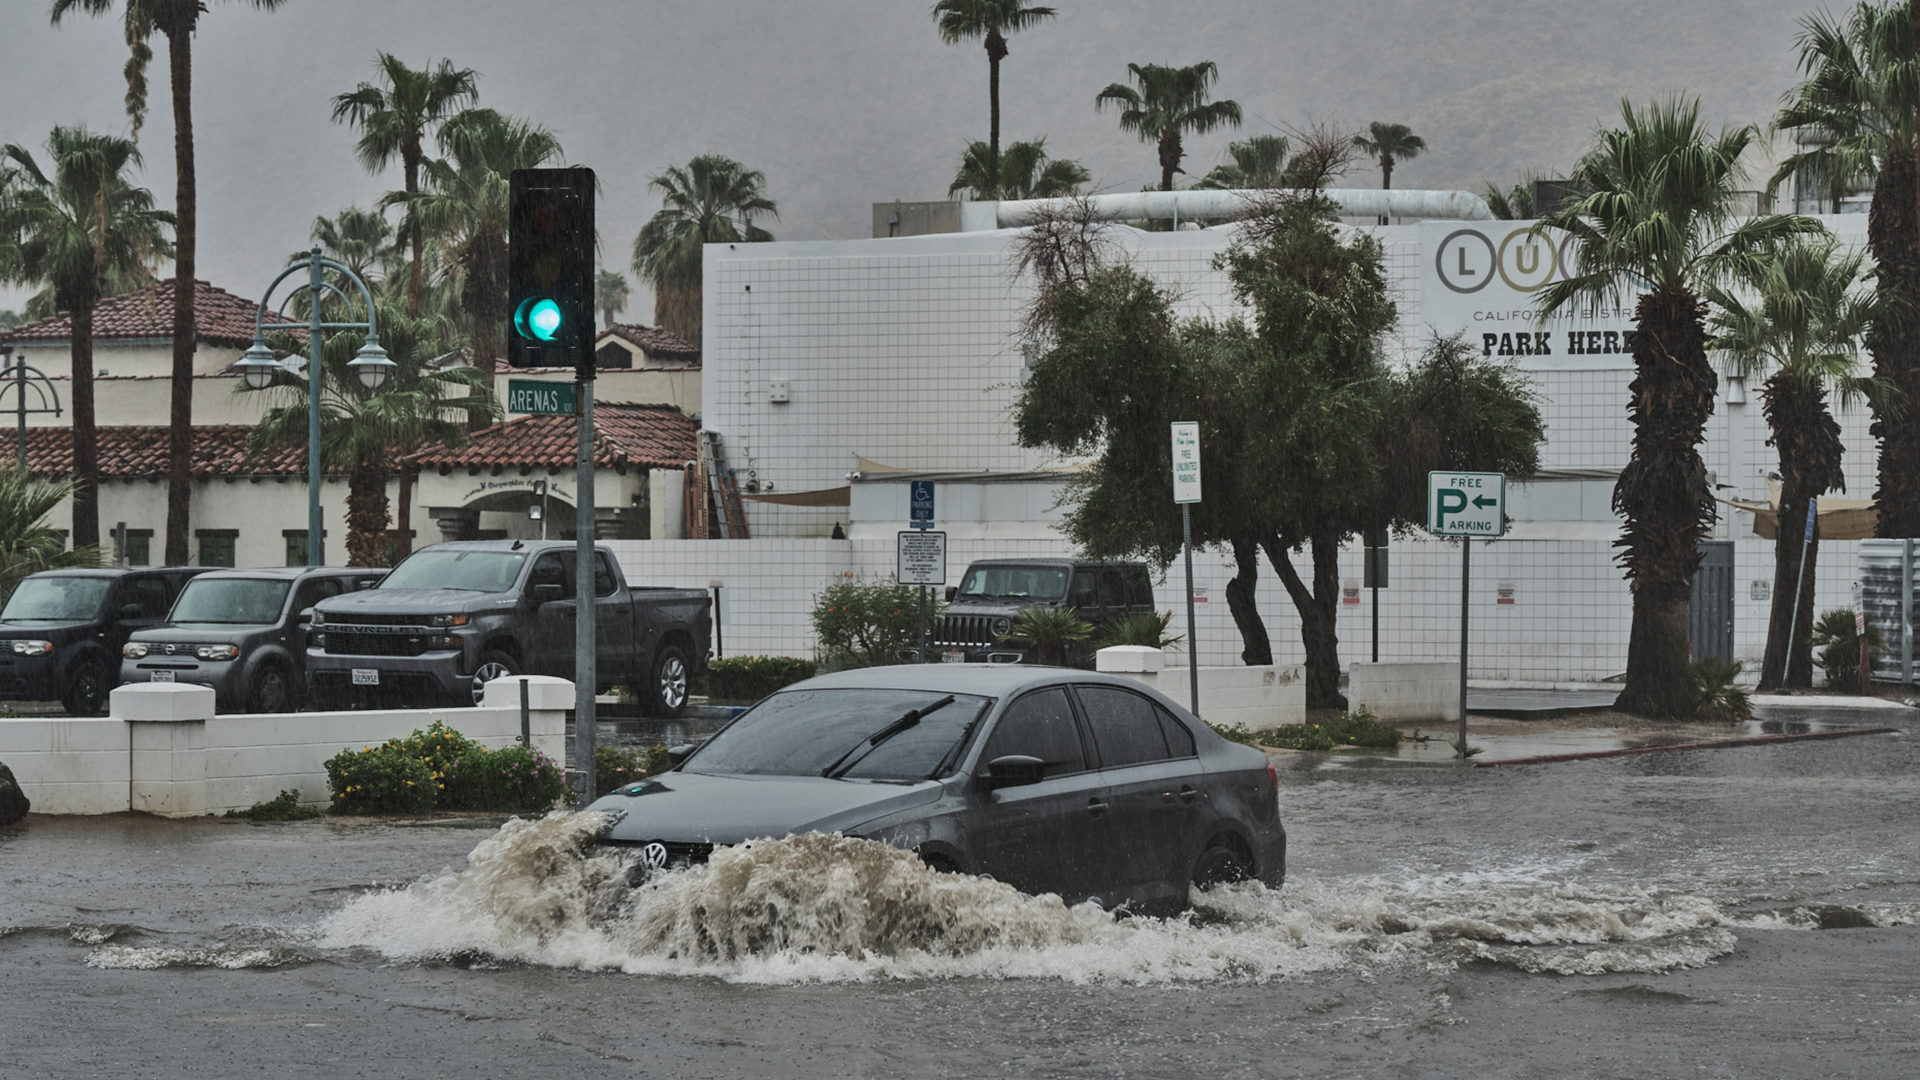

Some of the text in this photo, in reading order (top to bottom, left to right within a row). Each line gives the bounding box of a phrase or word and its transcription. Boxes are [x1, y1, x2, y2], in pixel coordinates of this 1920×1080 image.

[1482, 330, 1637, 356] PARK HERE
[509, 390, 572, 412] ARENAS 100
[1182, 450, 1191, 459] FREE
[1176, 462, 1197, 471] UNLIMITED
[1179, 474, 1196, 484] PARKING
[1450, 478, 1482, 488] FREE
[912, 501, 933, 509] PARKING
[916, 509, 929, 518] ONLY
[325, 625, 424, 634] CHEVROLET
